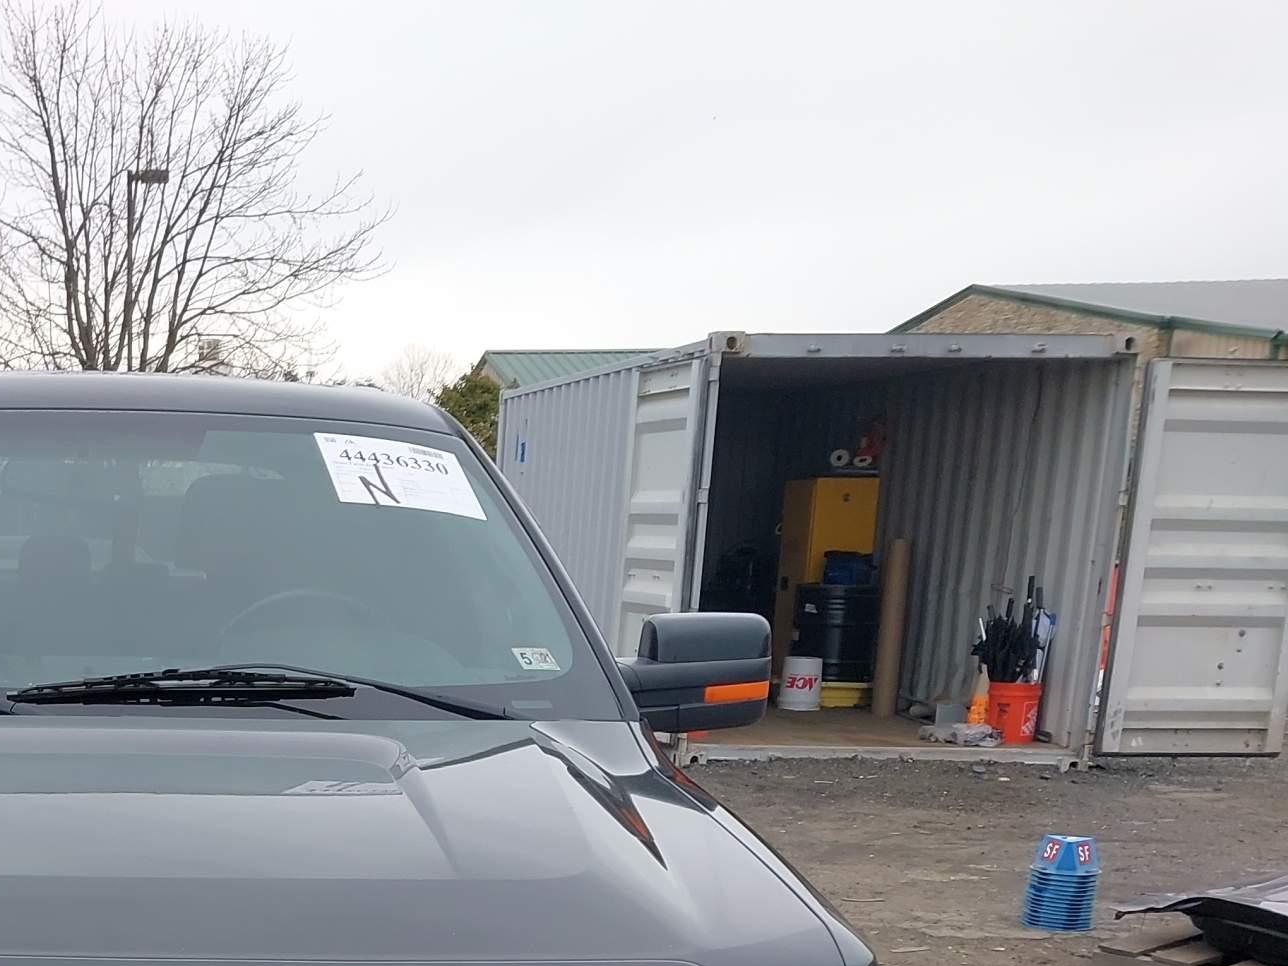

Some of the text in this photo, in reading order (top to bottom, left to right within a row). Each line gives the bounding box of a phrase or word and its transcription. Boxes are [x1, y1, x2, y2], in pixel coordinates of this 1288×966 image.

[339, 449, 448, 475] 44436330
[358, 463, 401, 506] N
[785, 676, 818, 691] ACE
[1043, 842, 1060, 860] SF
[1078, 845, 1091, 862] SF
